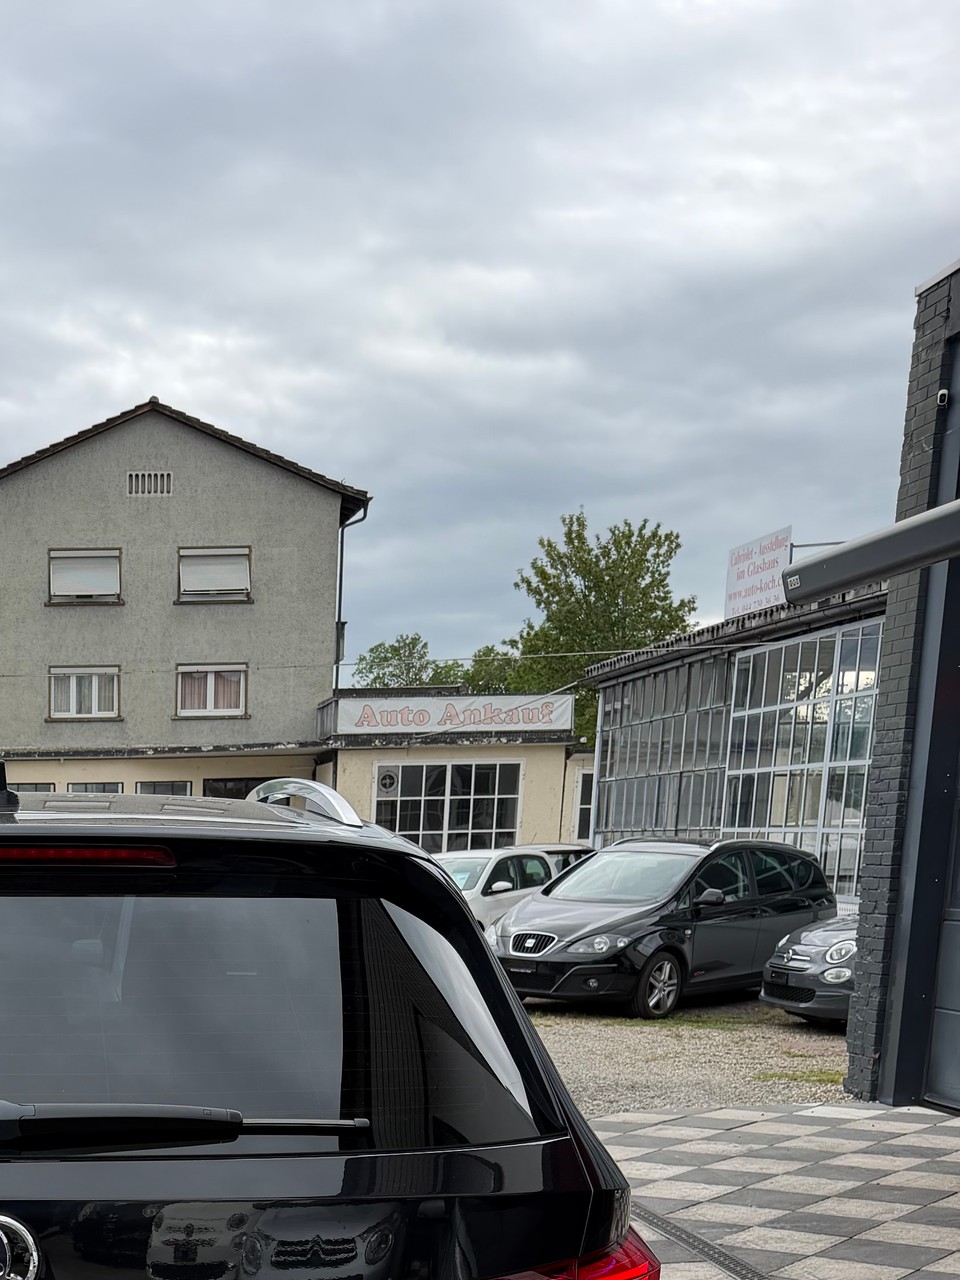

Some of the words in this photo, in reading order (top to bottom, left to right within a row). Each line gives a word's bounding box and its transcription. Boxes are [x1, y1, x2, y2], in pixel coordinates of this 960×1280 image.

[736, 567, 745, 581] im
[355, 704, 431, 728] Auto
[437, 702, 555, 726] Ankauf
